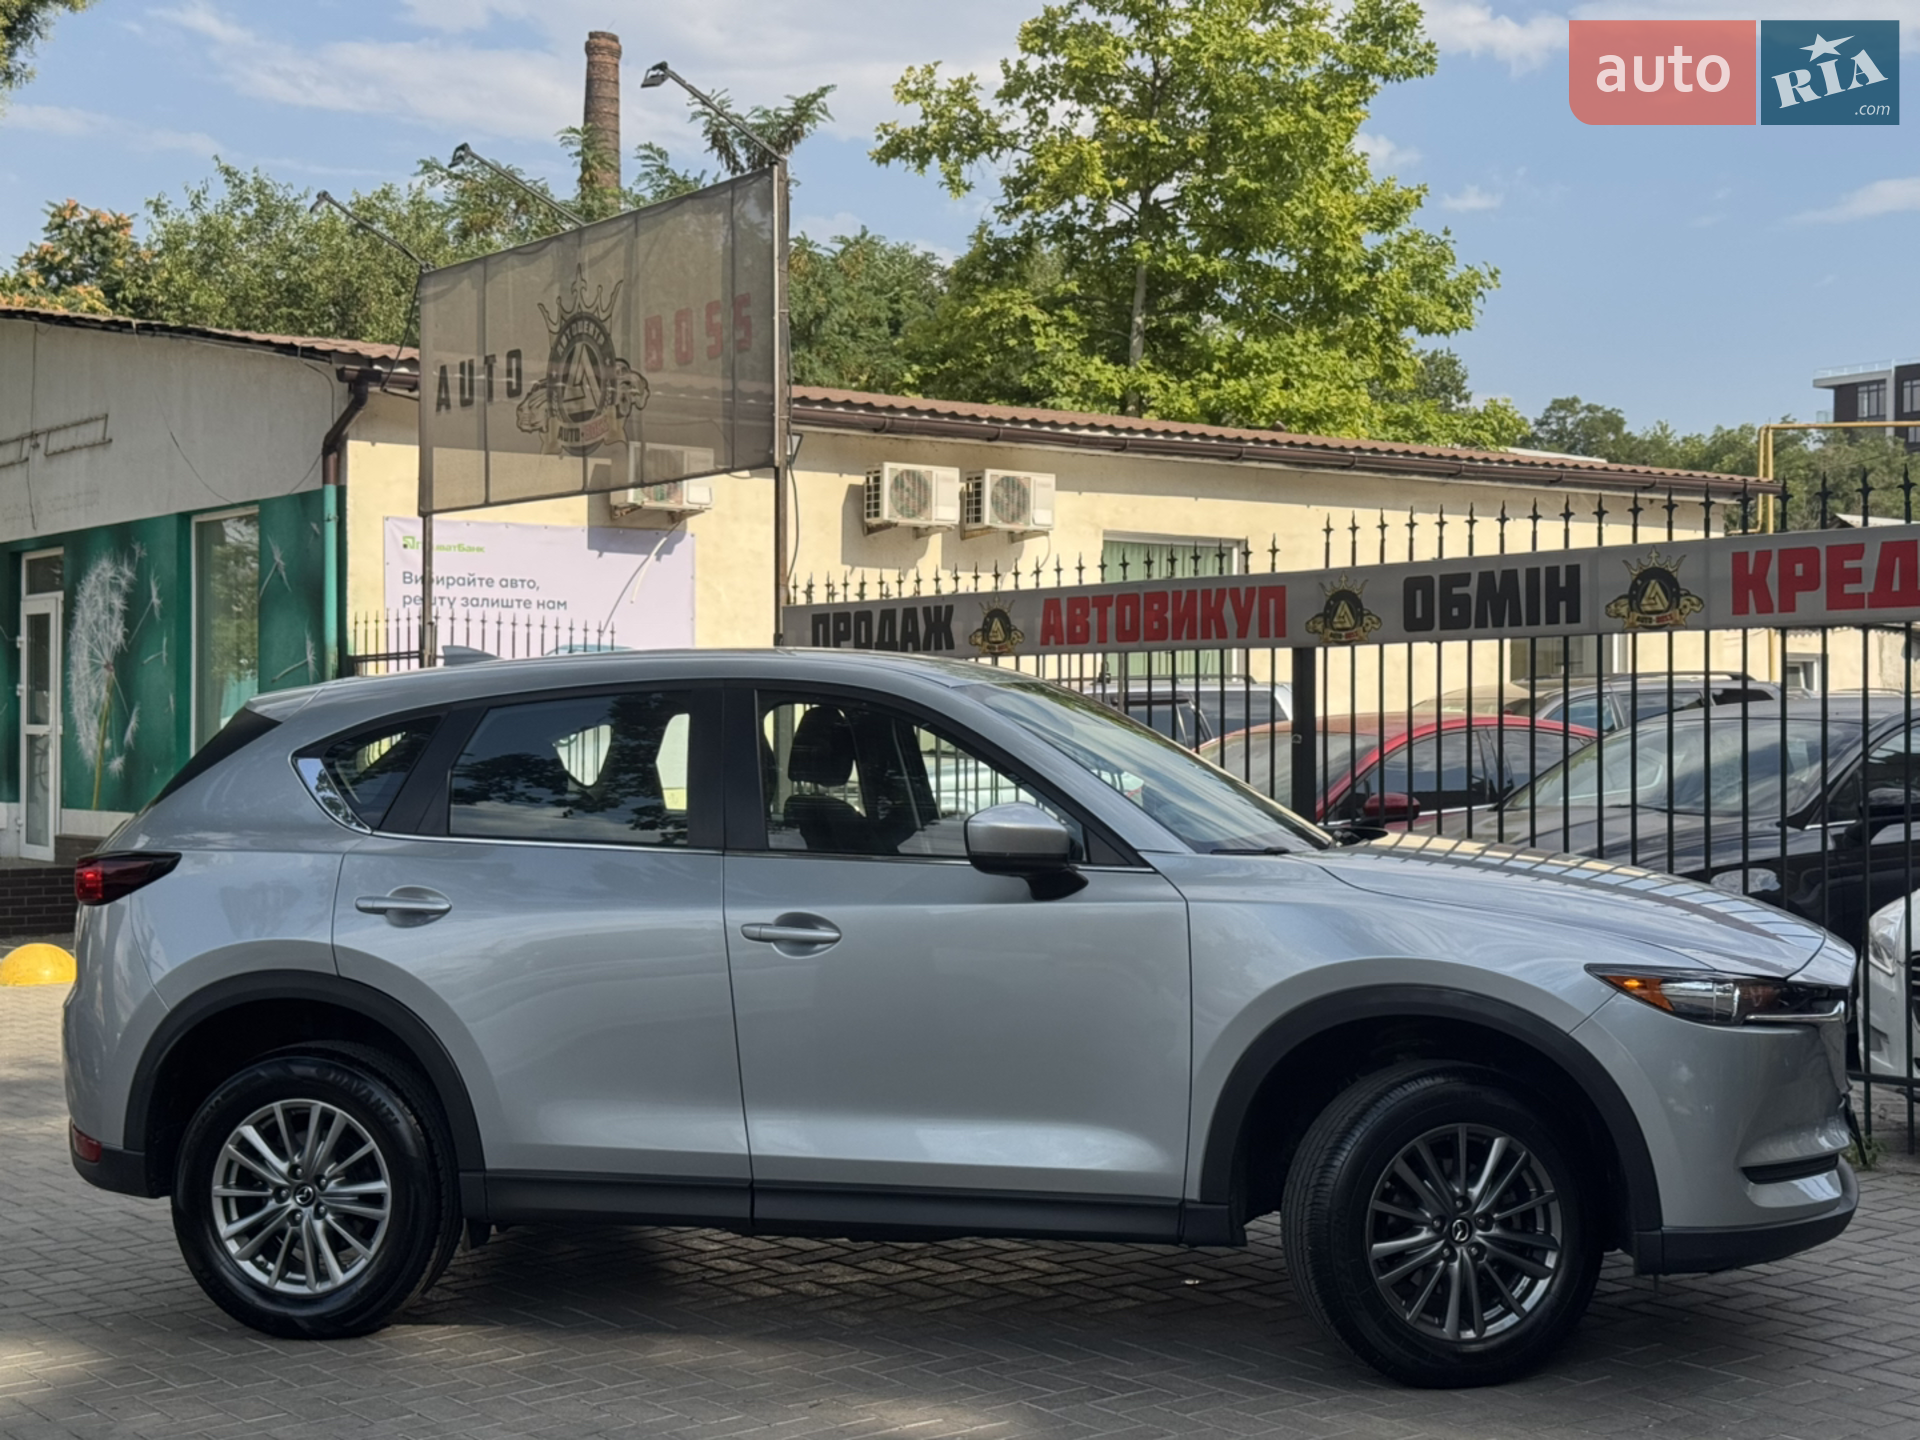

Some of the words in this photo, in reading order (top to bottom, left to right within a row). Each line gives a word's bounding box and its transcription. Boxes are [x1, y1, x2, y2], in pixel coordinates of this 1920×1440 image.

[435, 348, 522, 416] AUTO
[644, 293, 752, 373] BOSS
[402, 571, 495, 590] Виирайте
[499, 578, 540, 591] авто,
[461, 596, 532, 610] залиште
[536, 599, 568, 610] нам
[811, 604, 955, 652] ПРОДАЖ
[1040, 585, 1287, 647] АВТОВИКУП
[1403, 563, 1581, 633] ОБМІН
[1731, 539, 1920, 616] КРЕД
